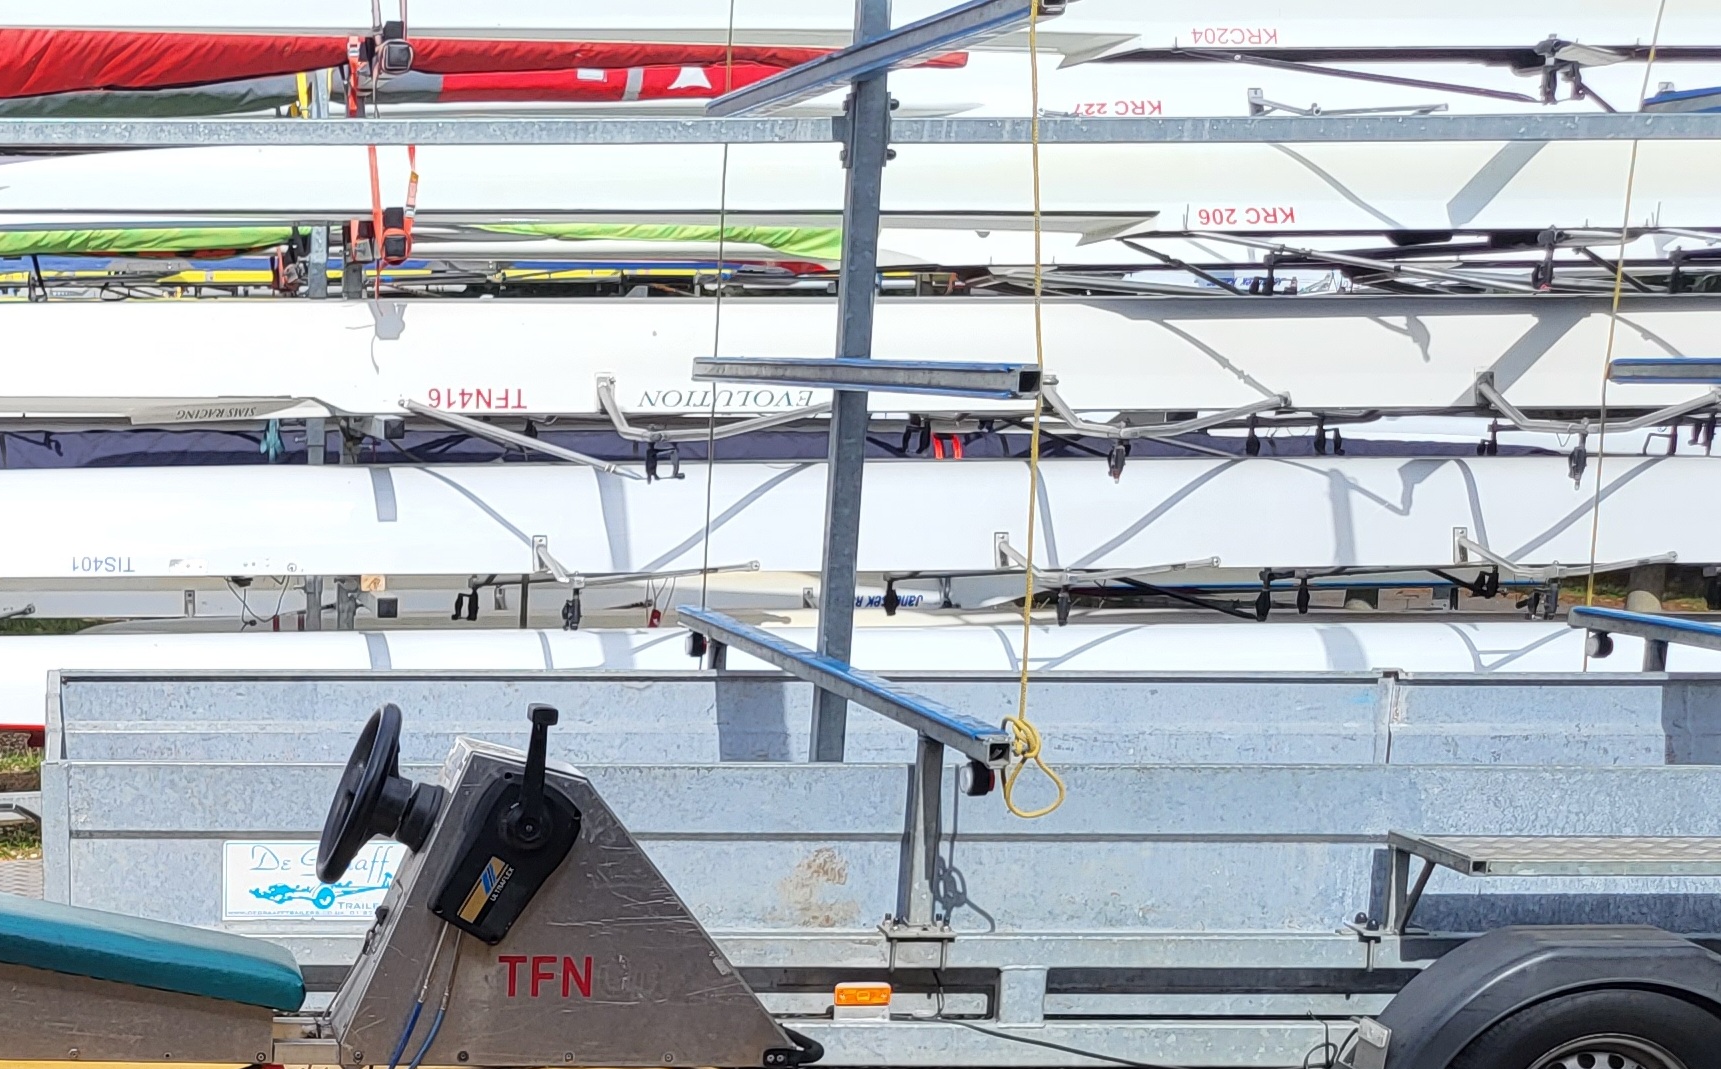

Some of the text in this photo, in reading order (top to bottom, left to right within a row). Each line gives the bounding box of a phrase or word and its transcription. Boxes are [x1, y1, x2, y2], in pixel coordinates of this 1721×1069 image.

[1191, 28, 1278, 44] KRC204
[1074, 100, 1163, 116] KRC 227
[1198, 207, 1296, 225] KRC 206
[427, 388, 528, 409] TFN416
[638, 389, 813, 407] EVOLUTION
[175, 406, 257, 420] SIMS RACING
[72, 556, 136, 573] TIS401
[865, 594, 924, 607] Jansek
[300, 846, 394, 883] Gaff
[490, 867, 515, 902] ULTRAFLEX
[498, 955, 593, 998] TFN
